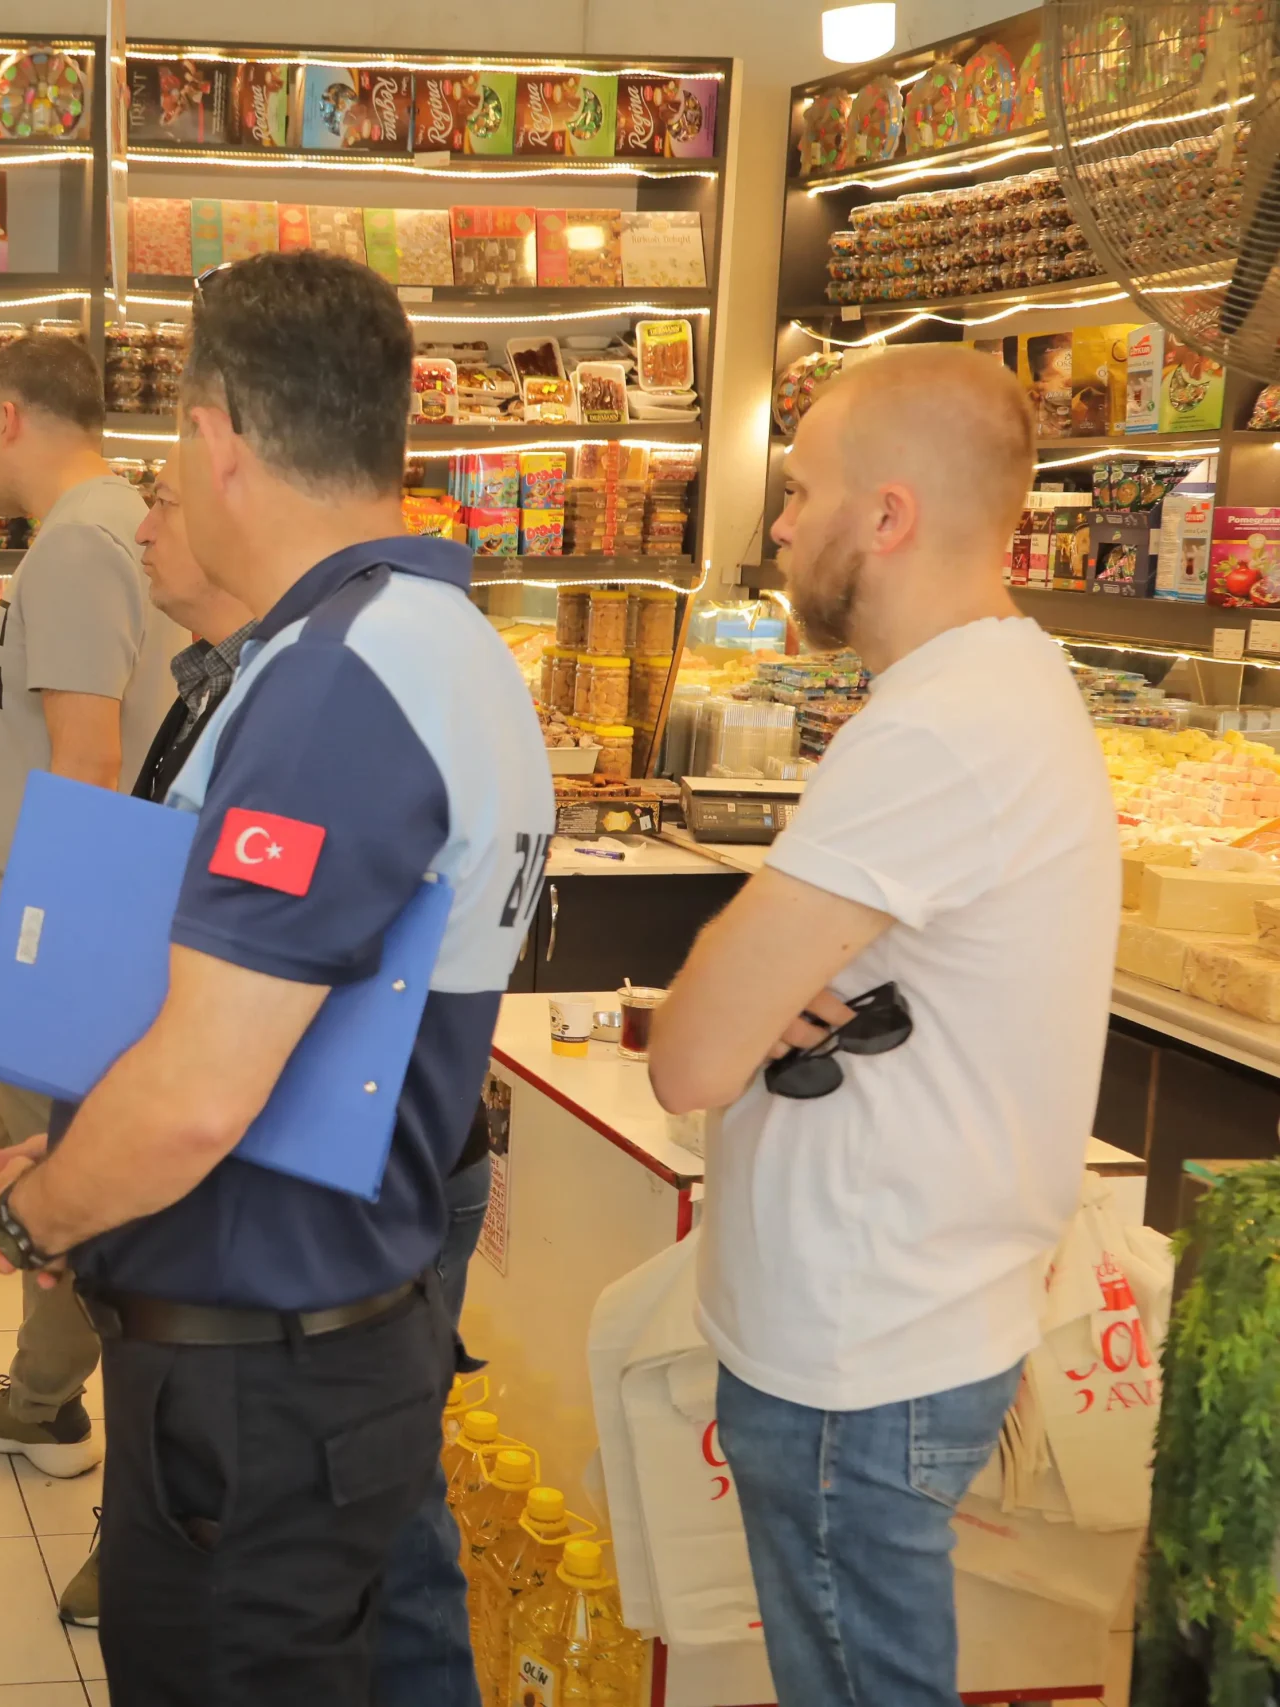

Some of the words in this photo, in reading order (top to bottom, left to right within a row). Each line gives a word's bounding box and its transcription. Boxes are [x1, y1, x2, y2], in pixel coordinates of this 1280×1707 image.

[372, 76, 397, 141] Regina
[427, 79, 453, 145] Regina
[527, 82, 553, 147] Regina
[628, 85, 654, 149] Regina
